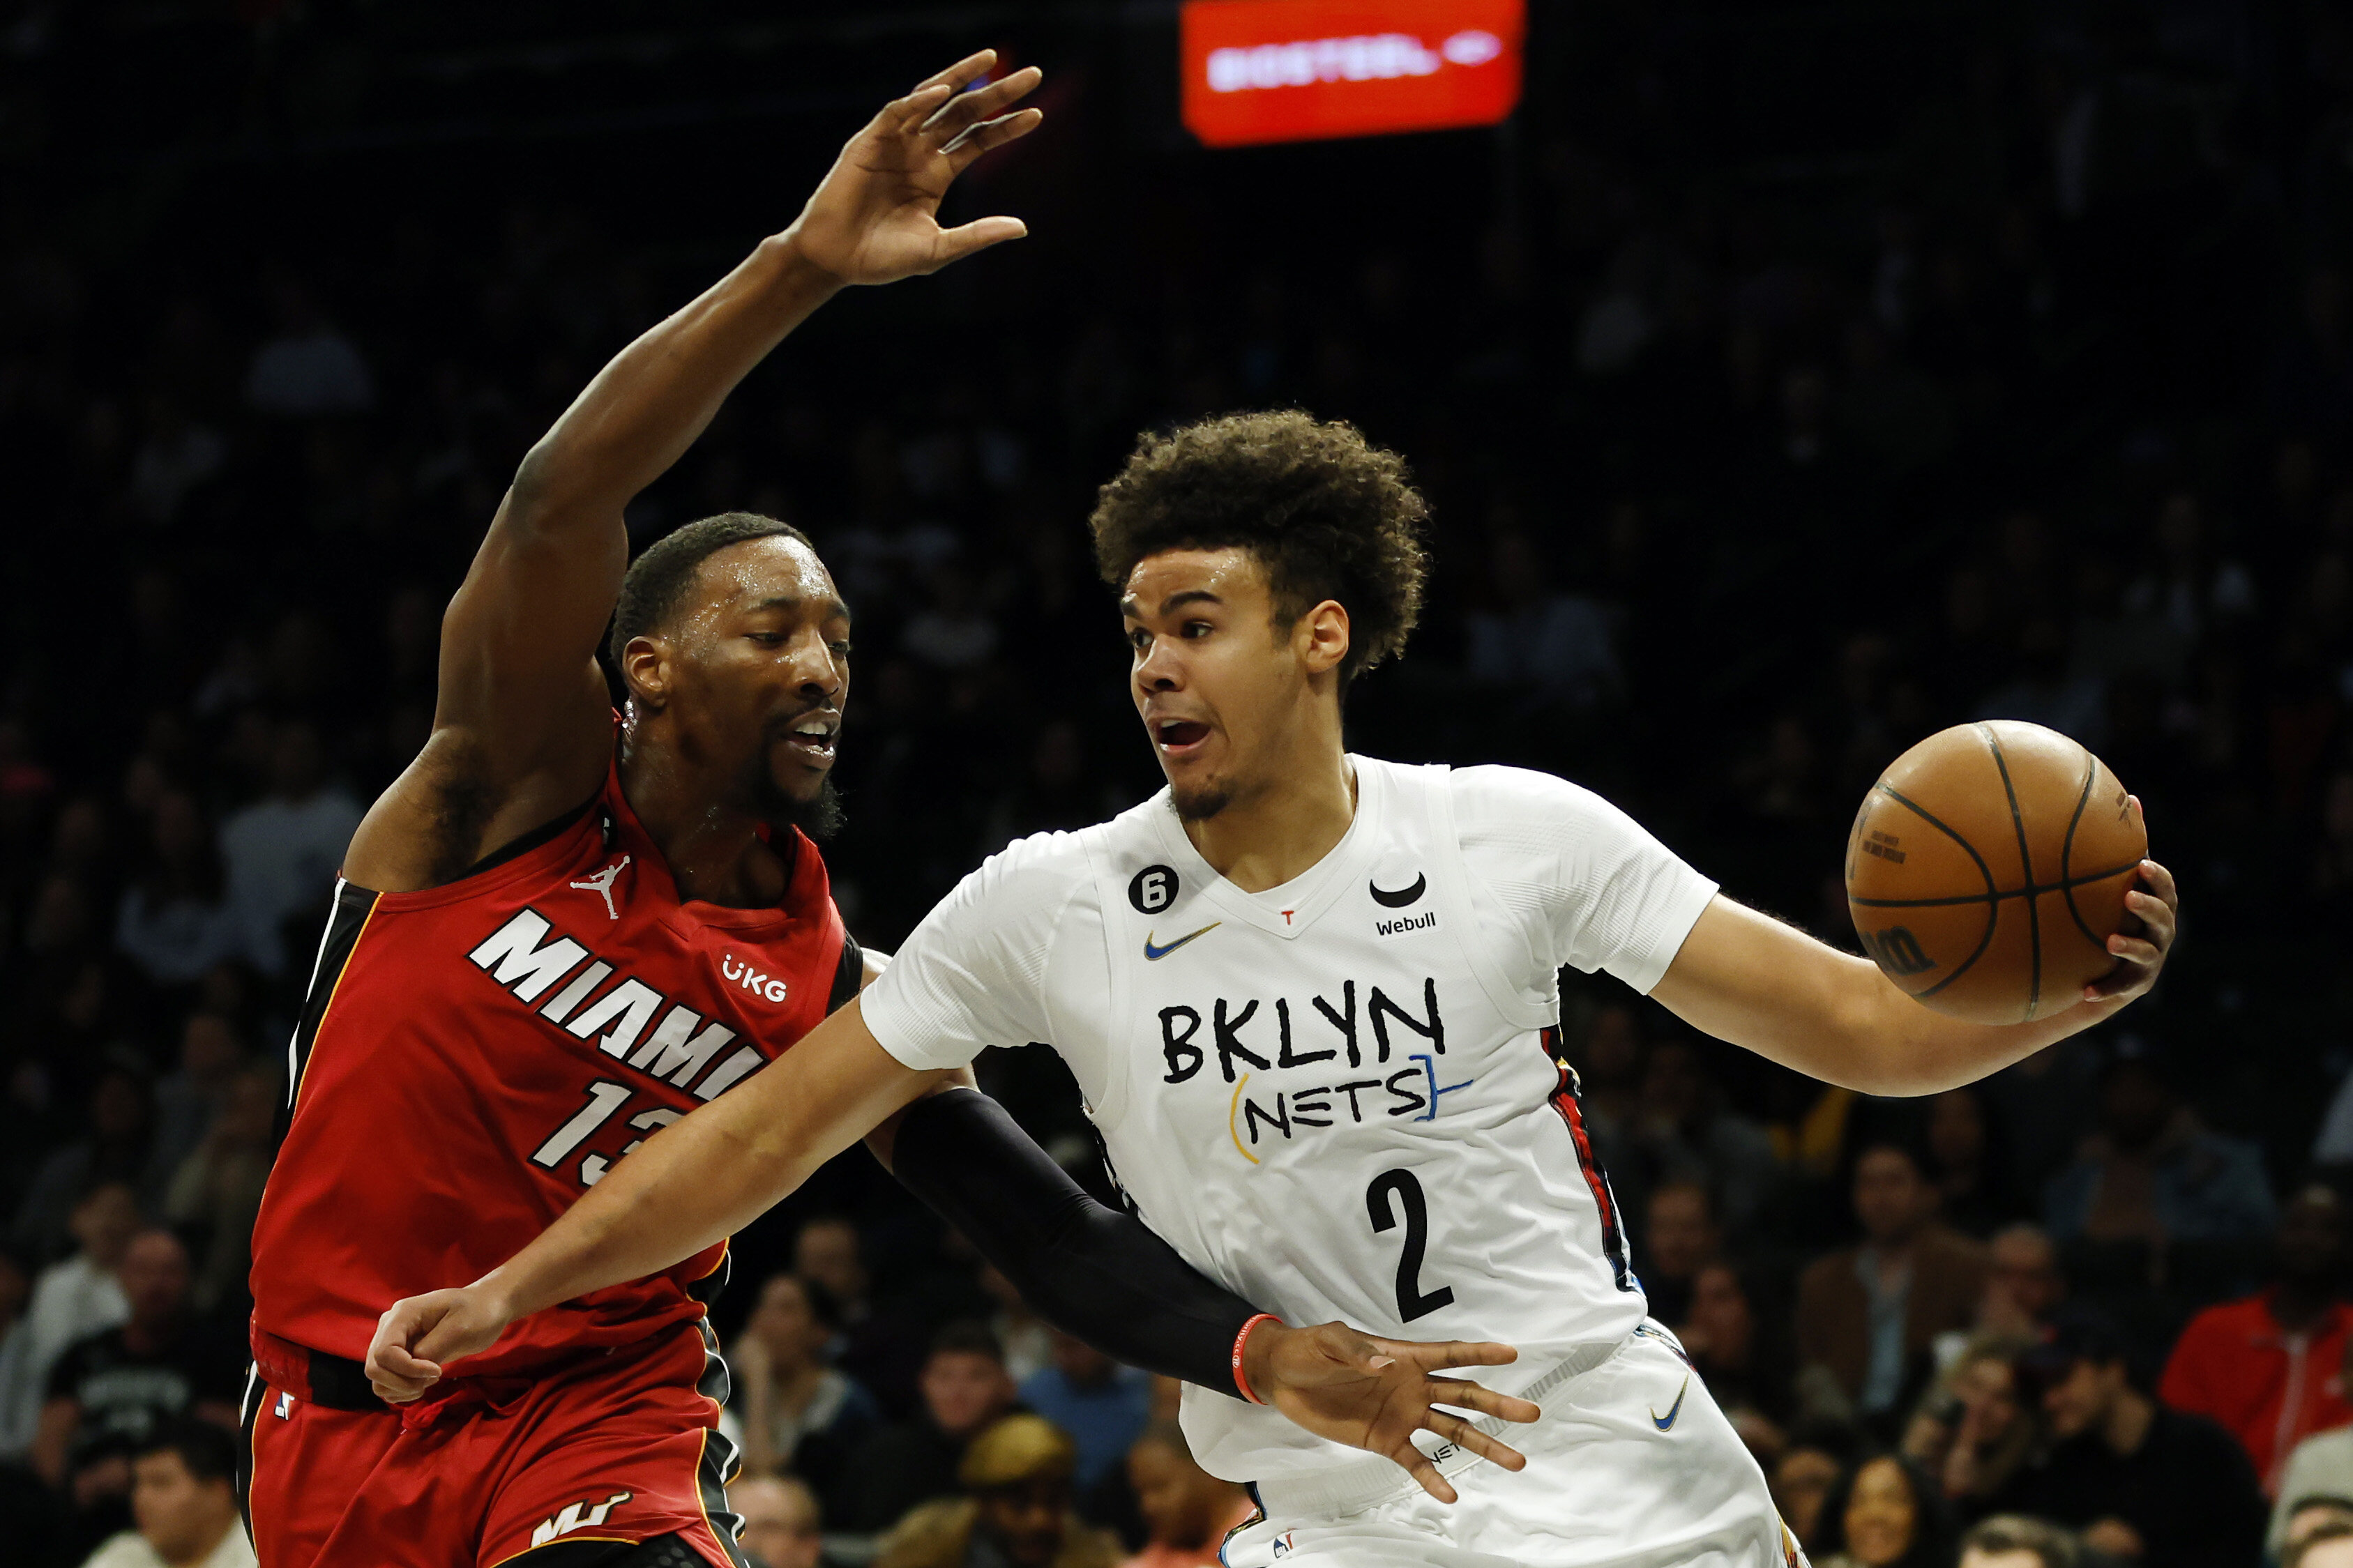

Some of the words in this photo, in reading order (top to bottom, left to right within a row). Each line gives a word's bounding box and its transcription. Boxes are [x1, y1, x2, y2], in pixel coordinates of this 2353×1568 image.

[1142, 871, 1167, 909] 6
[1376, 913, 1437, 936] Webull
[466, 906, 767, 1103] MIAMI
[1158, 977, 1446, 1083] BKLYN
[1366, 1169, 1455, 1323] 2
